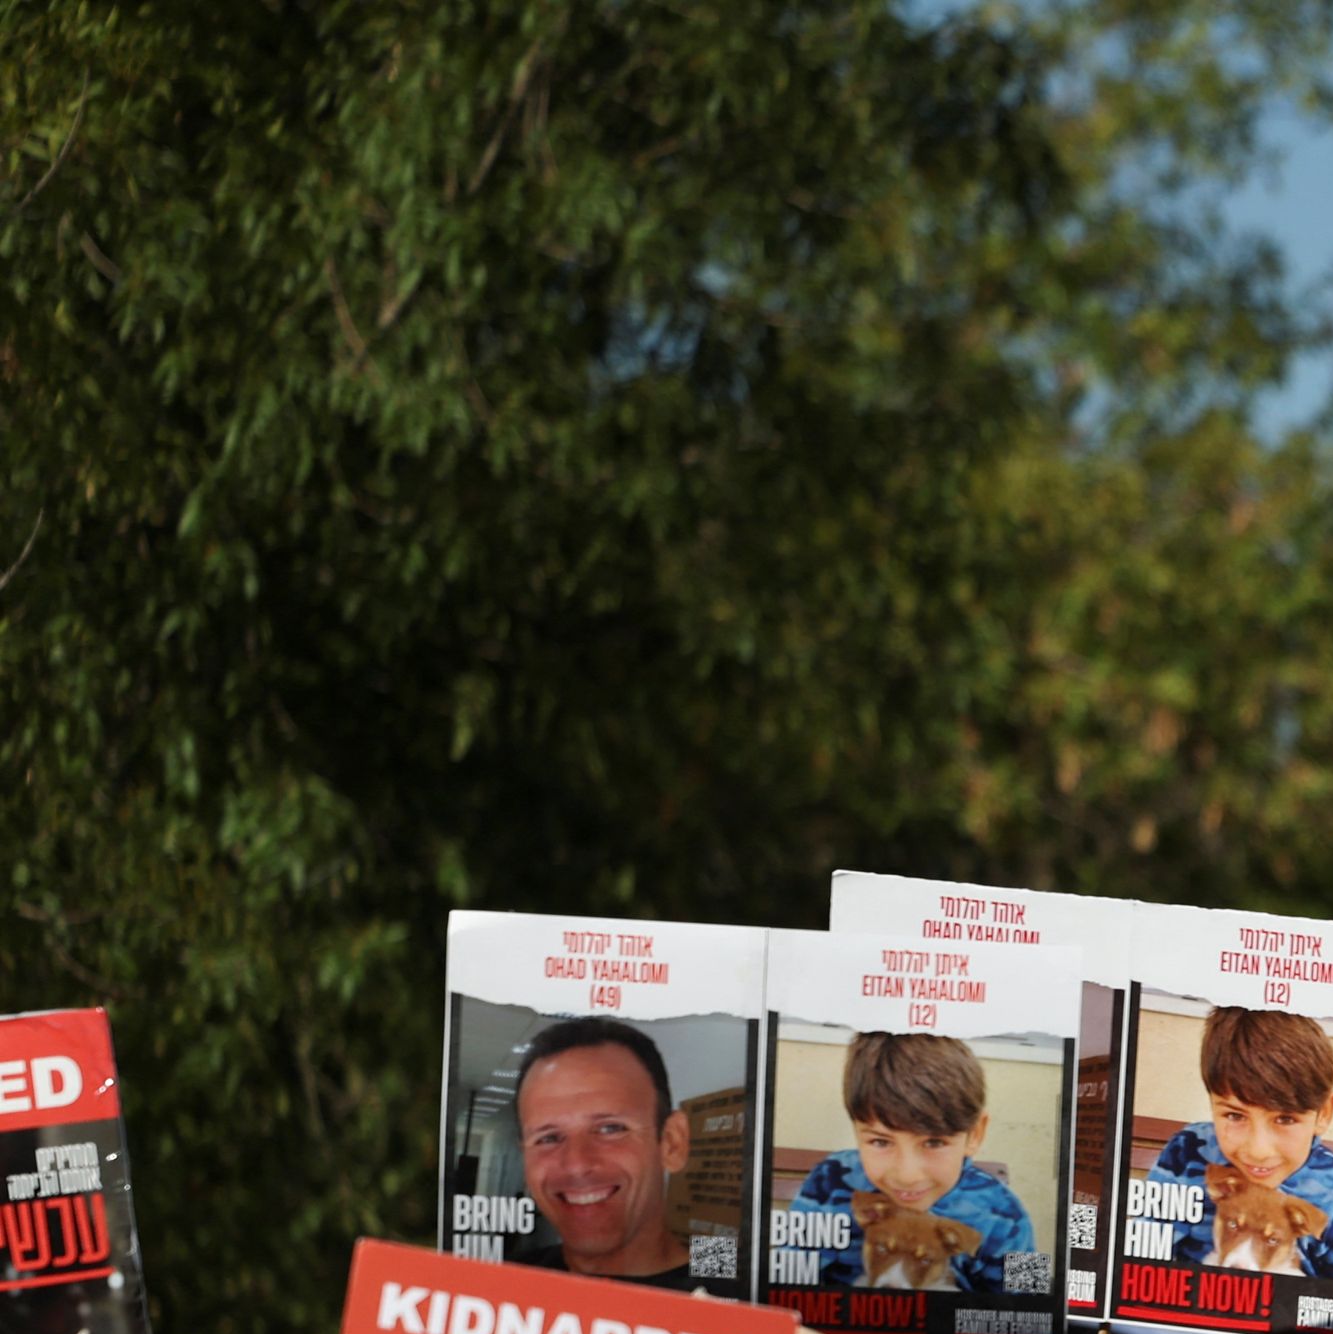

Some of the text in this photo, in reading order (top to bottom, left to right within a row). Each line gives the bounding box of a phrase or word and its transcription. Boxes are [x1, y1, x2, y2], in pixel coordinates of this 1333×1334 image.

[939, 896, 1025, 925] אוהד יהלומי
[562, 931, 653, 958] אוהד יהלומי
[1239, 928, 1322, 957] איתן יהלומי
[544, 957, 669, 985] OHAD YAHALOMI
[881, 949, 970, 976] איתן יהלומי
[1220, 951, 1259, 975] EITAN
[589, 985, 622, 1010] (49)
[861, 975, 986, 1003] EITAN YAHALOMI
[1264, 982, 1291, 1007] (12)
[908, 1004, 936, 1028] (12)
[452, 1194, 535, 1234] BRING
[1127, 1179, 1204, 1224] BRING
[770, 1209, 850, 1249] BRING
[1123, 1219, 1173, 1261] HIM
[452, 1234, 504, 1264] HIM
[768, 1249, 820, 1285] HIM
[1121, 1262, 1273, 1317] HOME NOW!
[851, 1292, 927, 1328] NOW!
